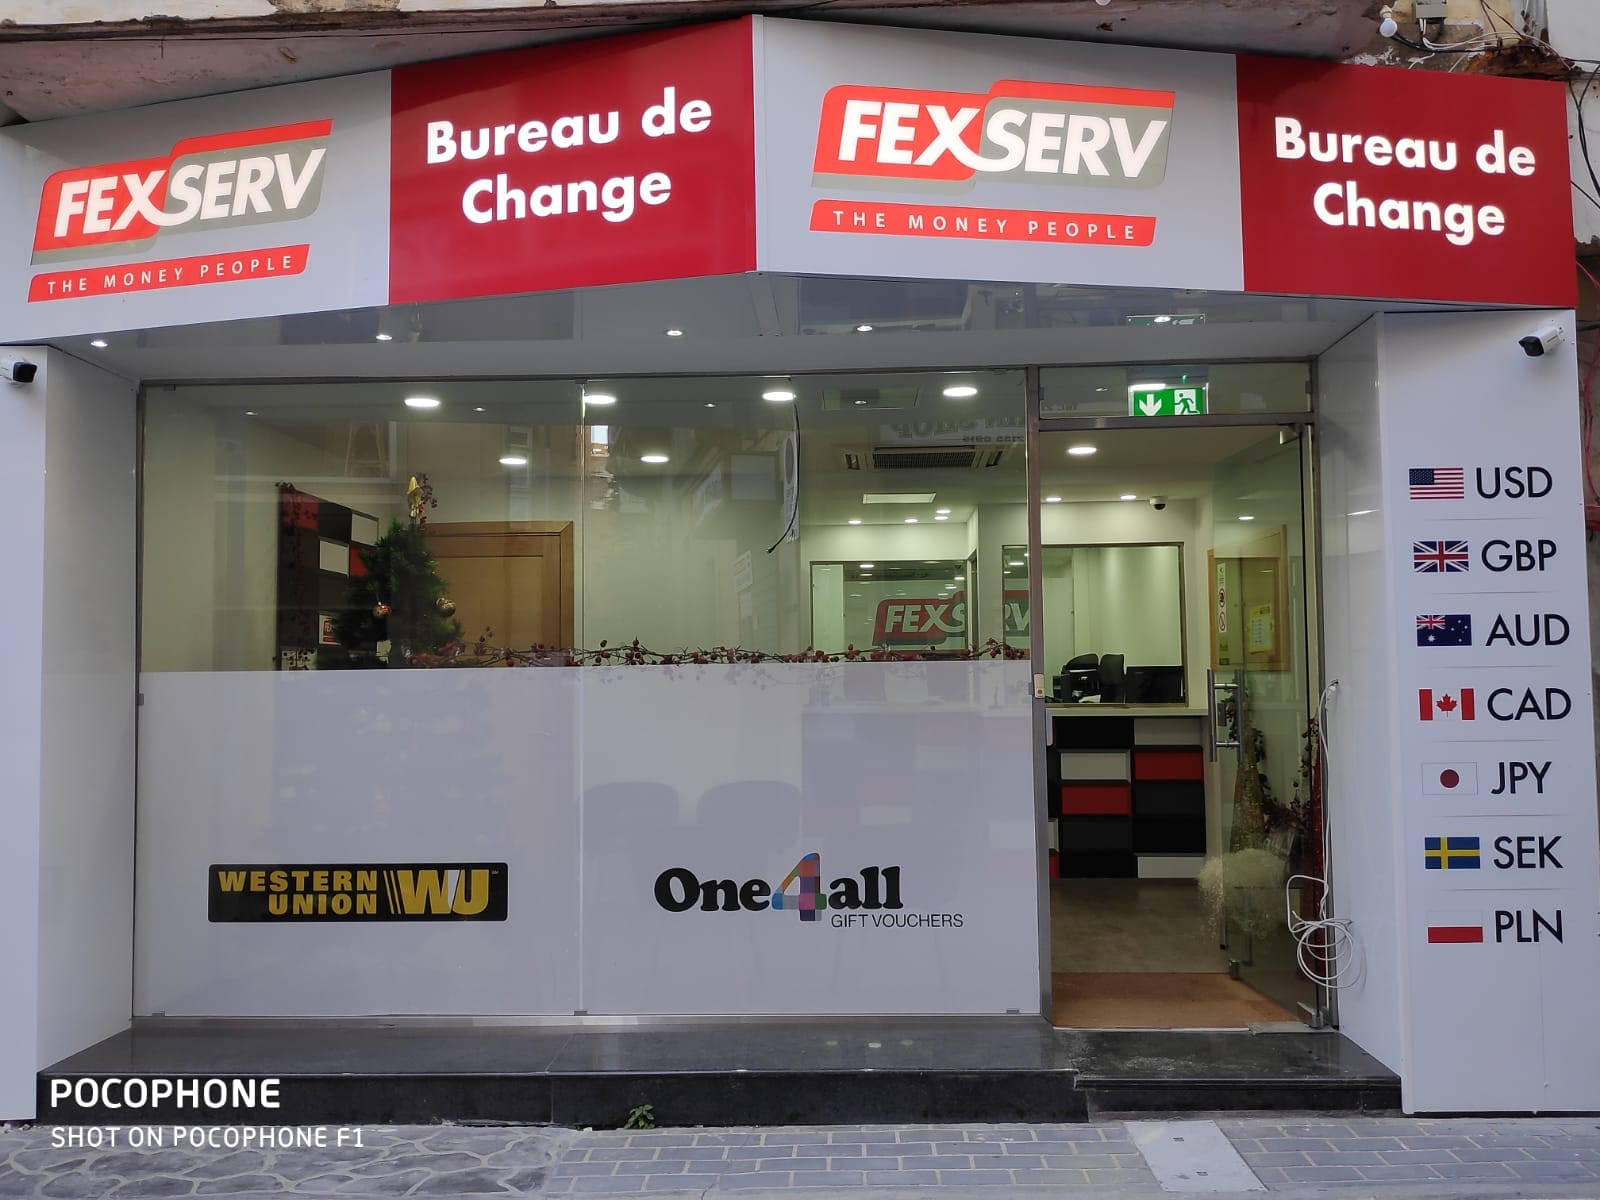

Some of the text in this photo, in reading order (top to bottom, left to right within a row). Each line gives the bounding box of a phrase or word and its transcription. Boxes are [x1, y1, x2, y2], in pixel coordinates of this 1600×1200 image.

[427, 86, 713, 165] Bureau de
[838, 99, 1168, 179] FEXSERV
[1274, 117, 1537, 177] Bureau de
[53, 148, 327, 239] FEXSERV
[461, 171, 672, 225] Change
[832, 210, 1135, 241] THE MONEY PEOPLE
[1312, 183, 1507, 247] Change
[47, 255, 292, 295] THE MONEY PEOPLE
[1476, 466, 1554, 500] USD
[1481, 539, 1558, 572] GBP
[1485, 613, 1571, 647] AUD
[1487, 687, 1572, 721] CAD
[1491, 761, 1552, 795] JPY
[1493, 836, 1563, 870] SEK
[218, 870, 377, 892] WESTERN
[397, 868, 490, 915] WU
[653, 851, 904, 922] One4all
[268, 894, 377, 915] UNION
[831, 912, 964, 928] GIFT VOUCHERS
[1495, 910, 1564, 944] PLN
